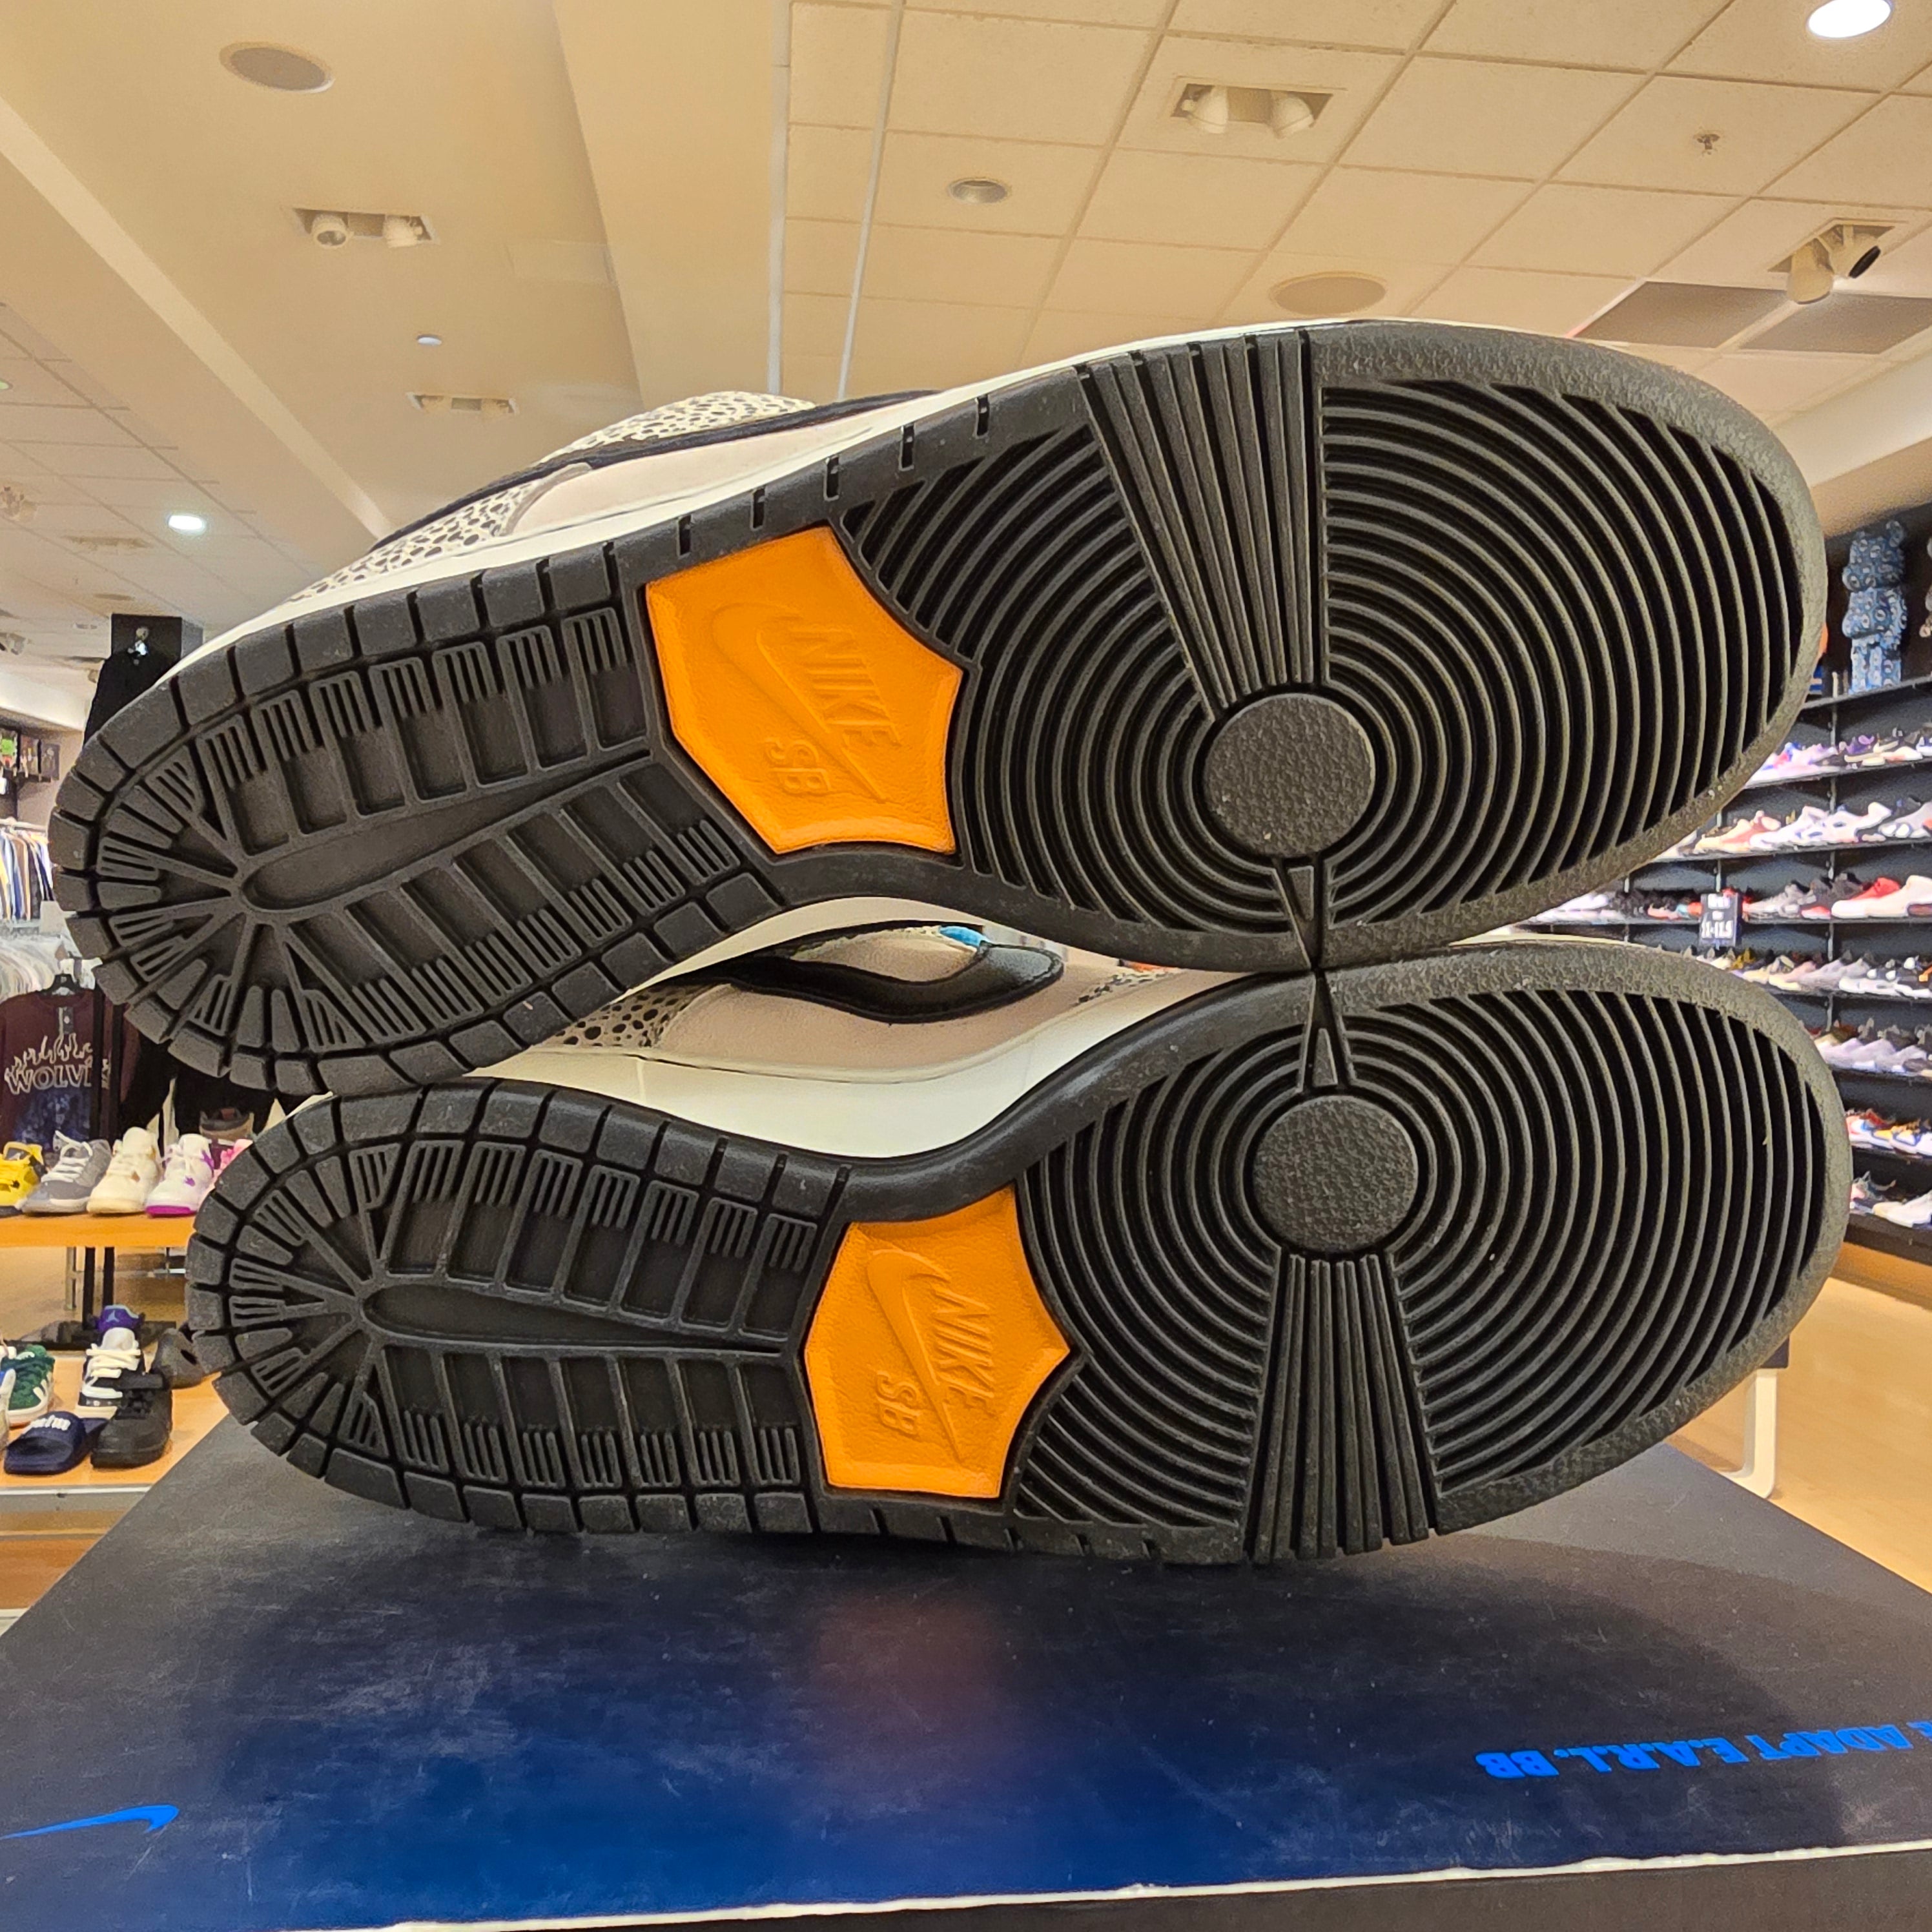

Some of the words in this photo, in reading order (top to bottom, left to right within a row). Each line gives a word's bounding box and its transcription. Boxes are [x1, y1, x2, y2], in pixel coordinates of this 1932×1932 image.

[784, 624, 902, 747] NIKE
[766, 737, 832, 797] SB
[931, 1282, 996, 1417] NIKE
[876, 1370, 920, 1436] SB
[1475, 1750, 1559, 1779] BB
[1553, 1736, 1750, 1773] E.A.R.L.
[1745, 1724, 1914, 1761] ADAPT
